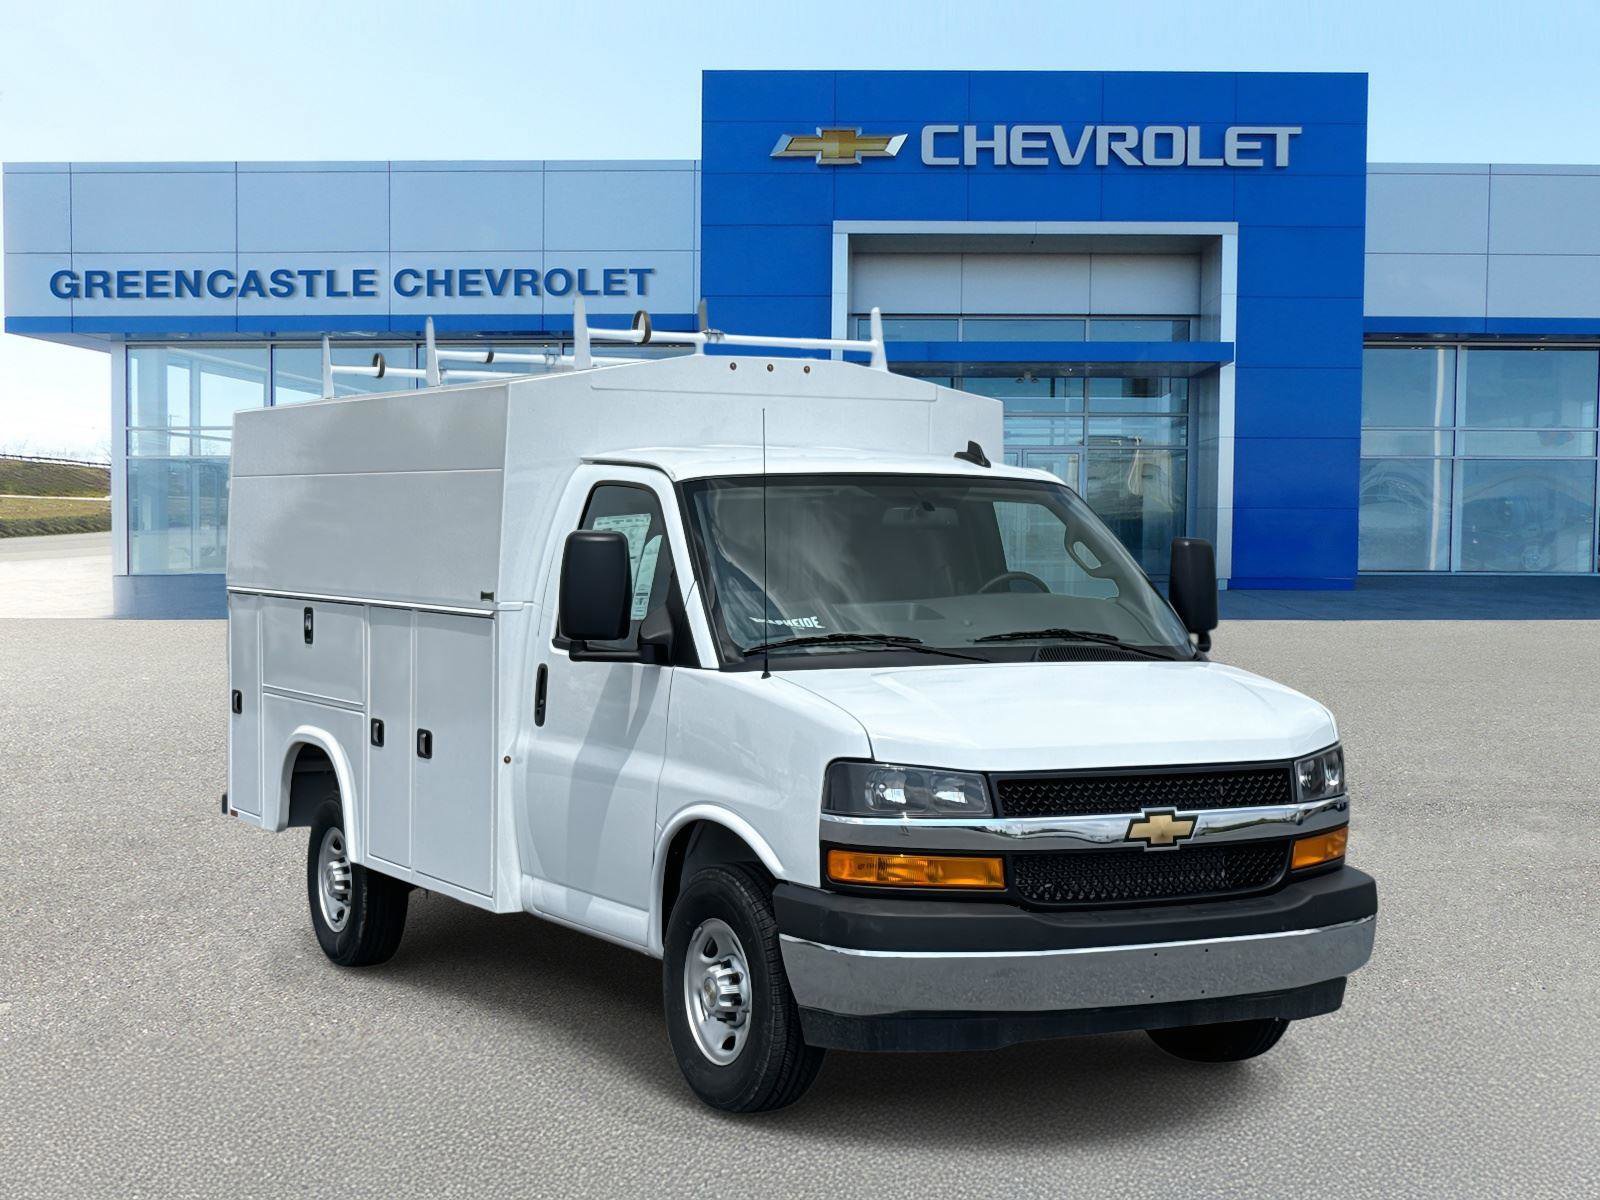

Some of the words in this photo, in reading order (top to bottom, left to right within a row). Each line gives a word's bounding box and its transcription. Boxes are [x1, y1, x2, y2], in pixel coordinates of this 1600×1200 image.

[920, 124, 1303, 168] CHEVROLET
[49, 268, 378, 299] GREENCASTLE
[393, 266, 655, 297] CHEVROLET
